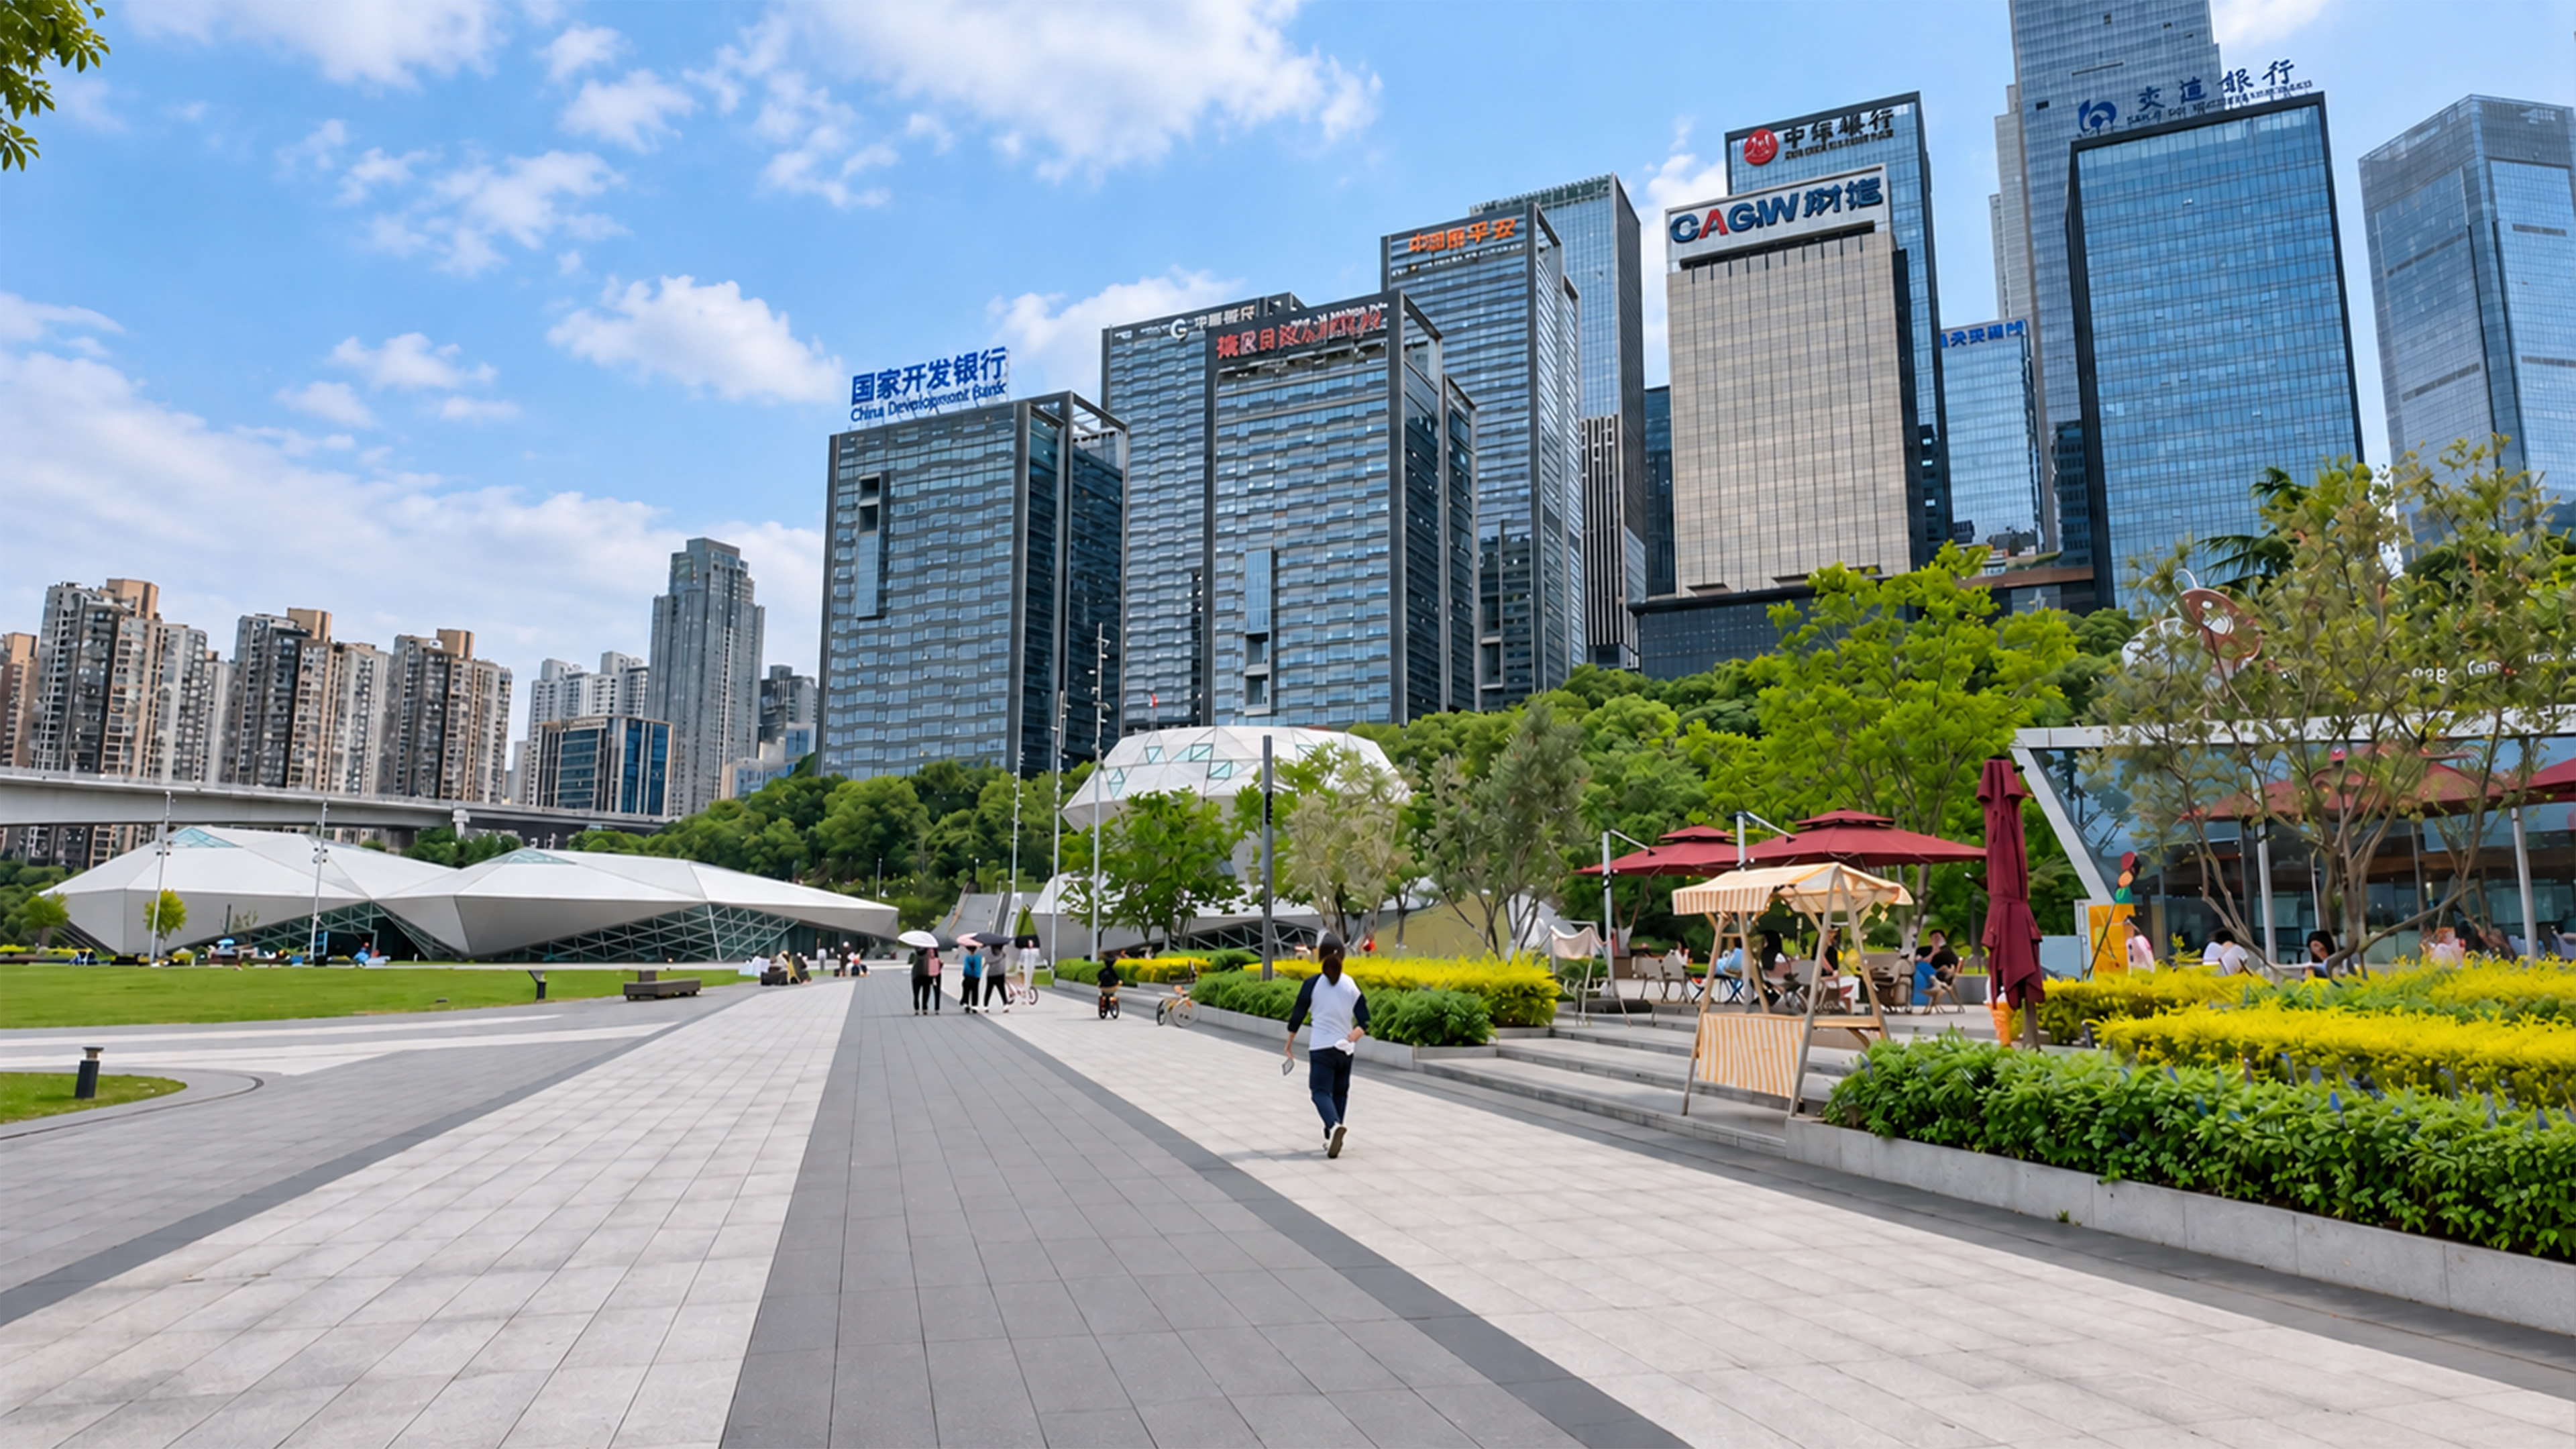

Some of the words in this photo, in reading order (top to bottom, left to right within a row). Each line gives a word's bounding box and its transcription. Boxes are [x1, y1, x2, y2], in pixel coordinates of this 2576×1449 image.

[851, 346, 1006, 405] 国家开发银行
